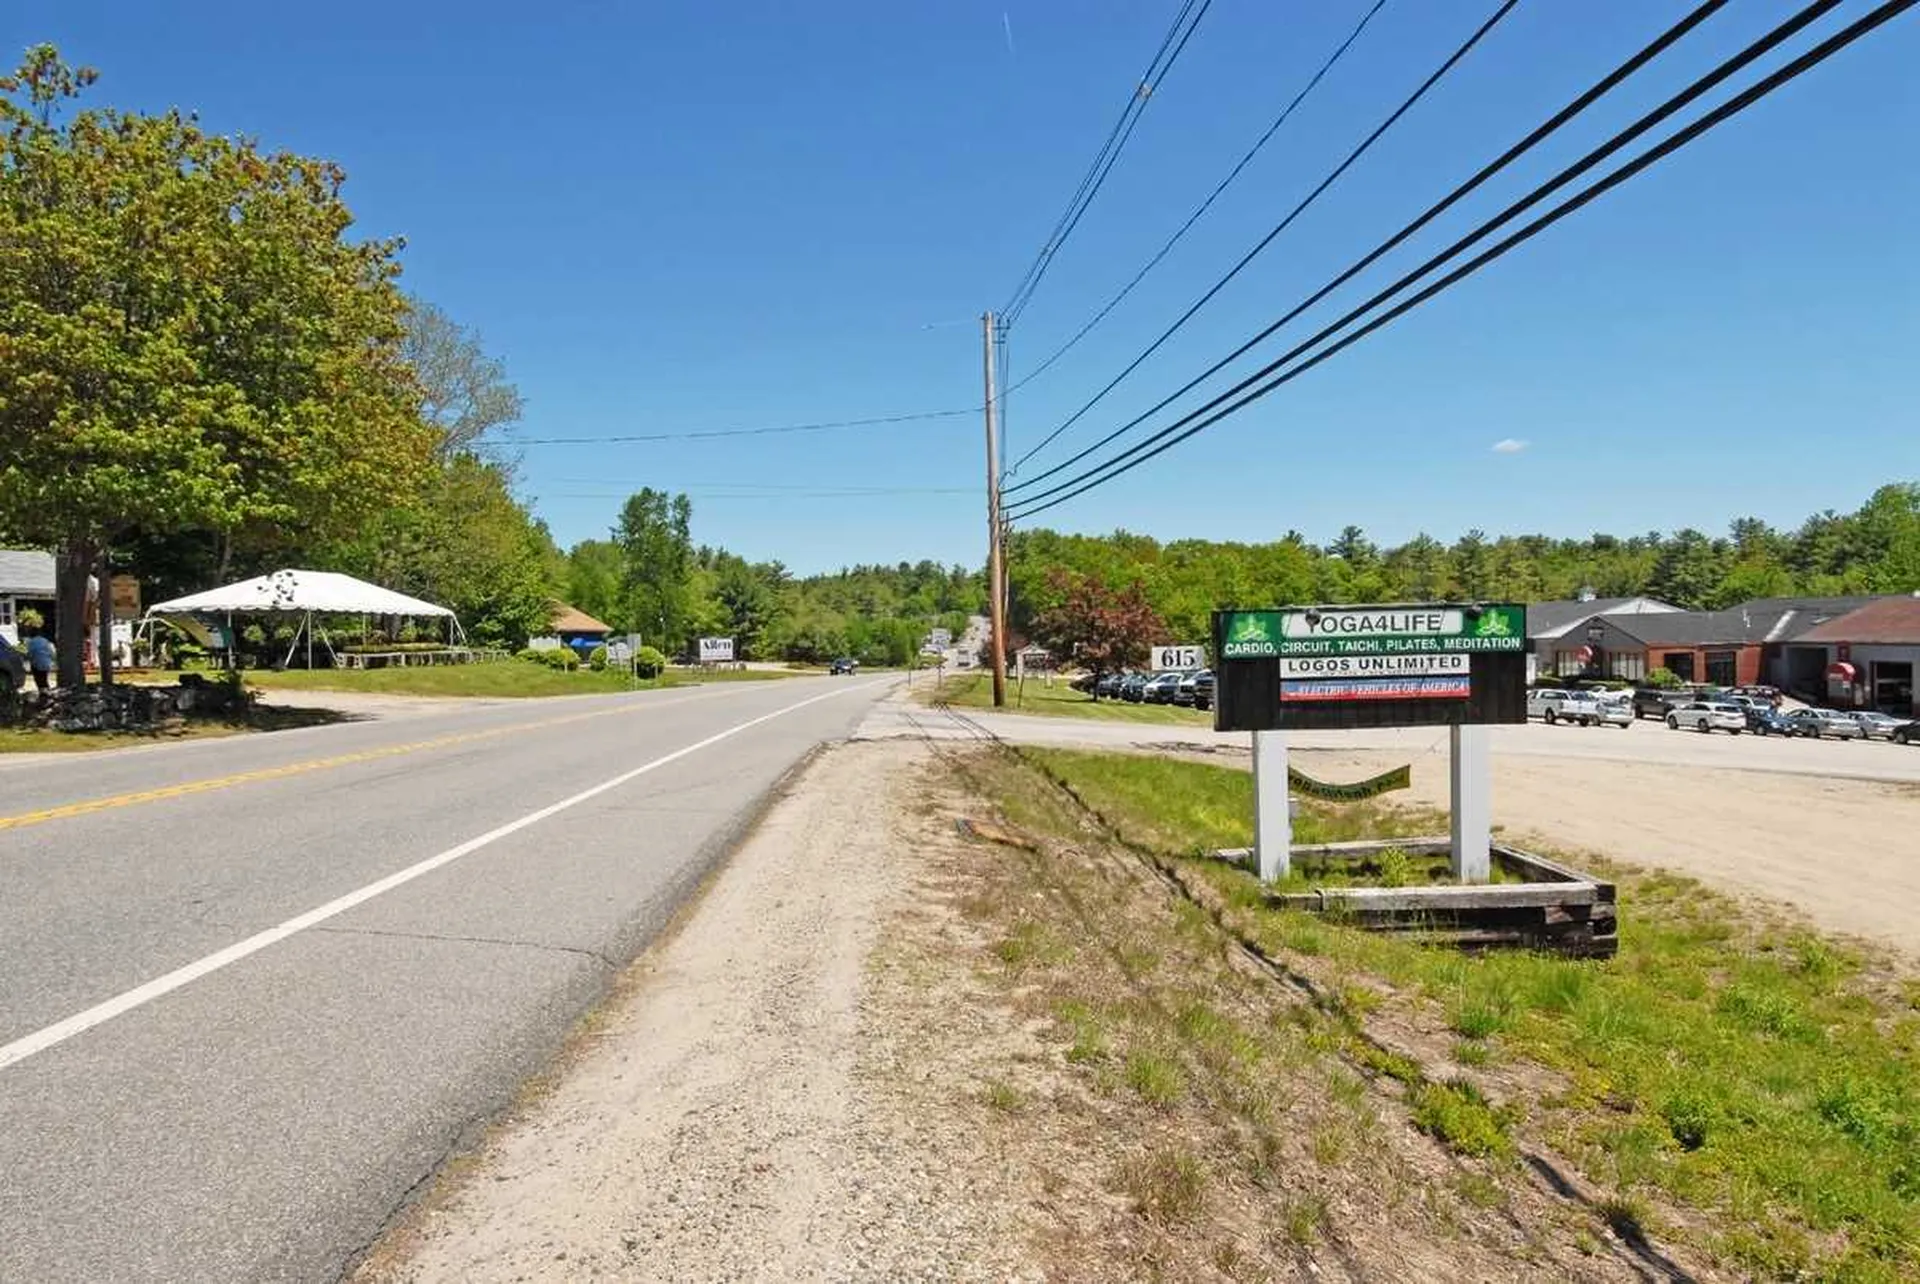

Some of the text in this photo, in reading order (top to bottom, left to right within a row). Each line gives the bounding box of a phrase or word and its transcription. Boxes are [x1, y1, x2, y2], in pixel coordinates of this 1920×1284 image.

[1224, 637, 1521, 654] CARDIO, CIRCUIT, TAICHI, PILATES, MEDITATION
[1161, 649, 1196, 667] 615
[1288, 656, 1462, 672] LOGOS UNLIMITED
